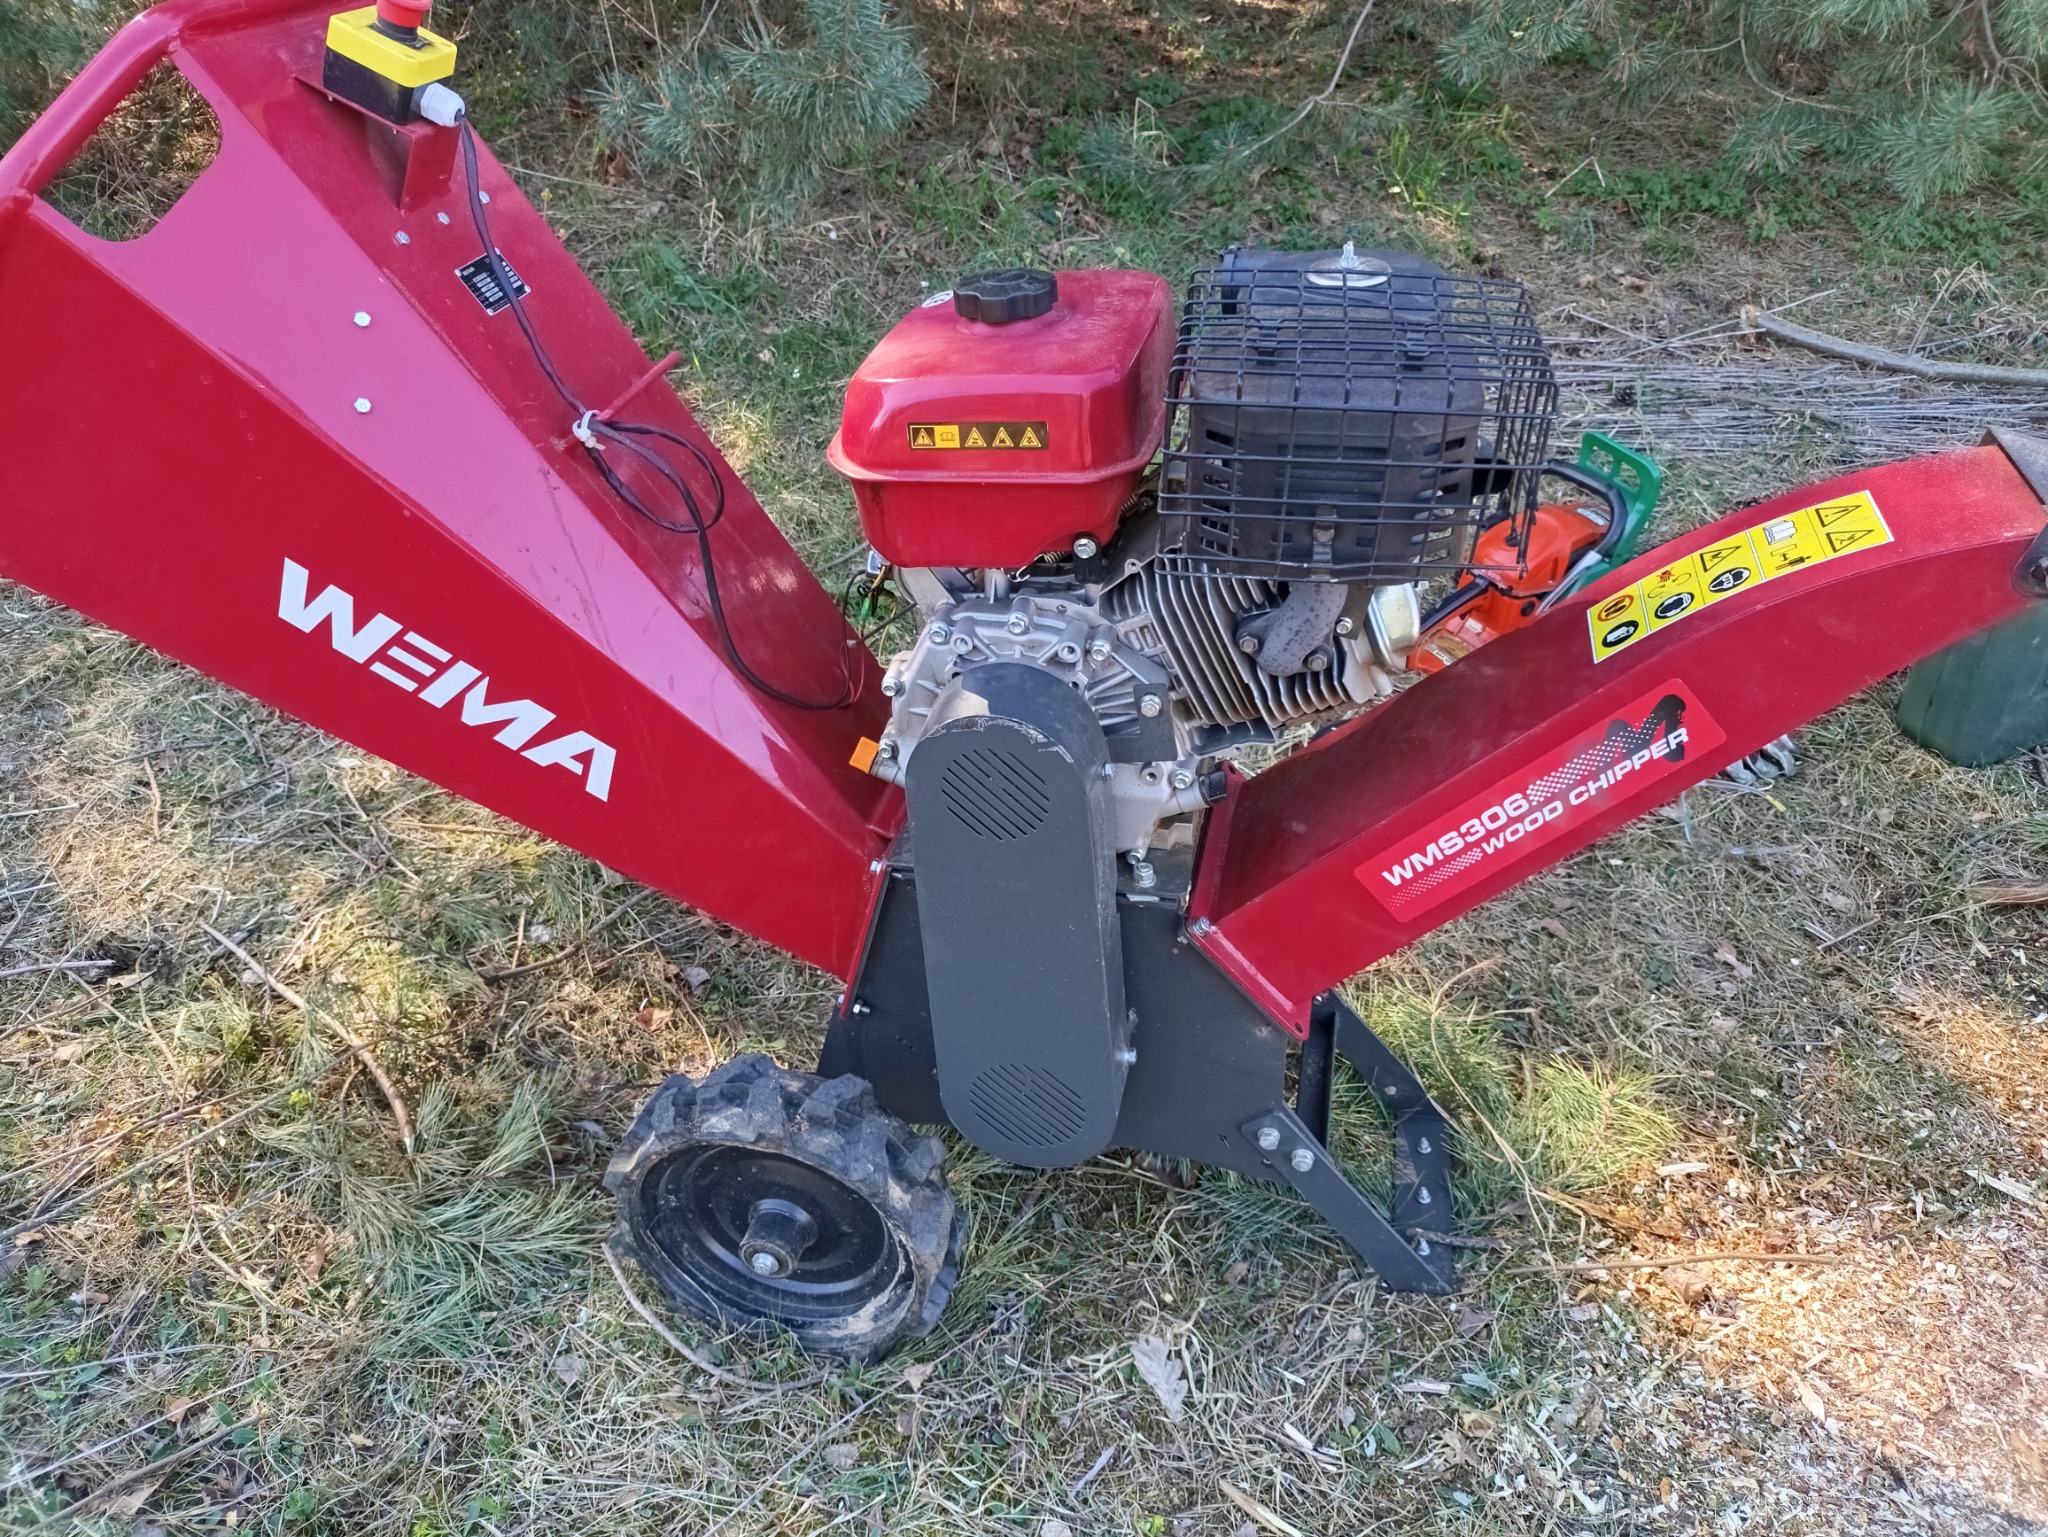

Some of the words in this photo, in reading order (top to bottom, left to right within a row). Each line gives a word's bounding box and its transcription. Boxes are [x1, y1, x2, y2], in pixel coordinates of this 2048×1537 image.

[278, 557, 617, 803] WEIMA
[1382, 793, 1530, 886] WMS306
[1481, 801, 1564, 855] WOOD
[1569, 727, 1689, 806] CHIPPER
